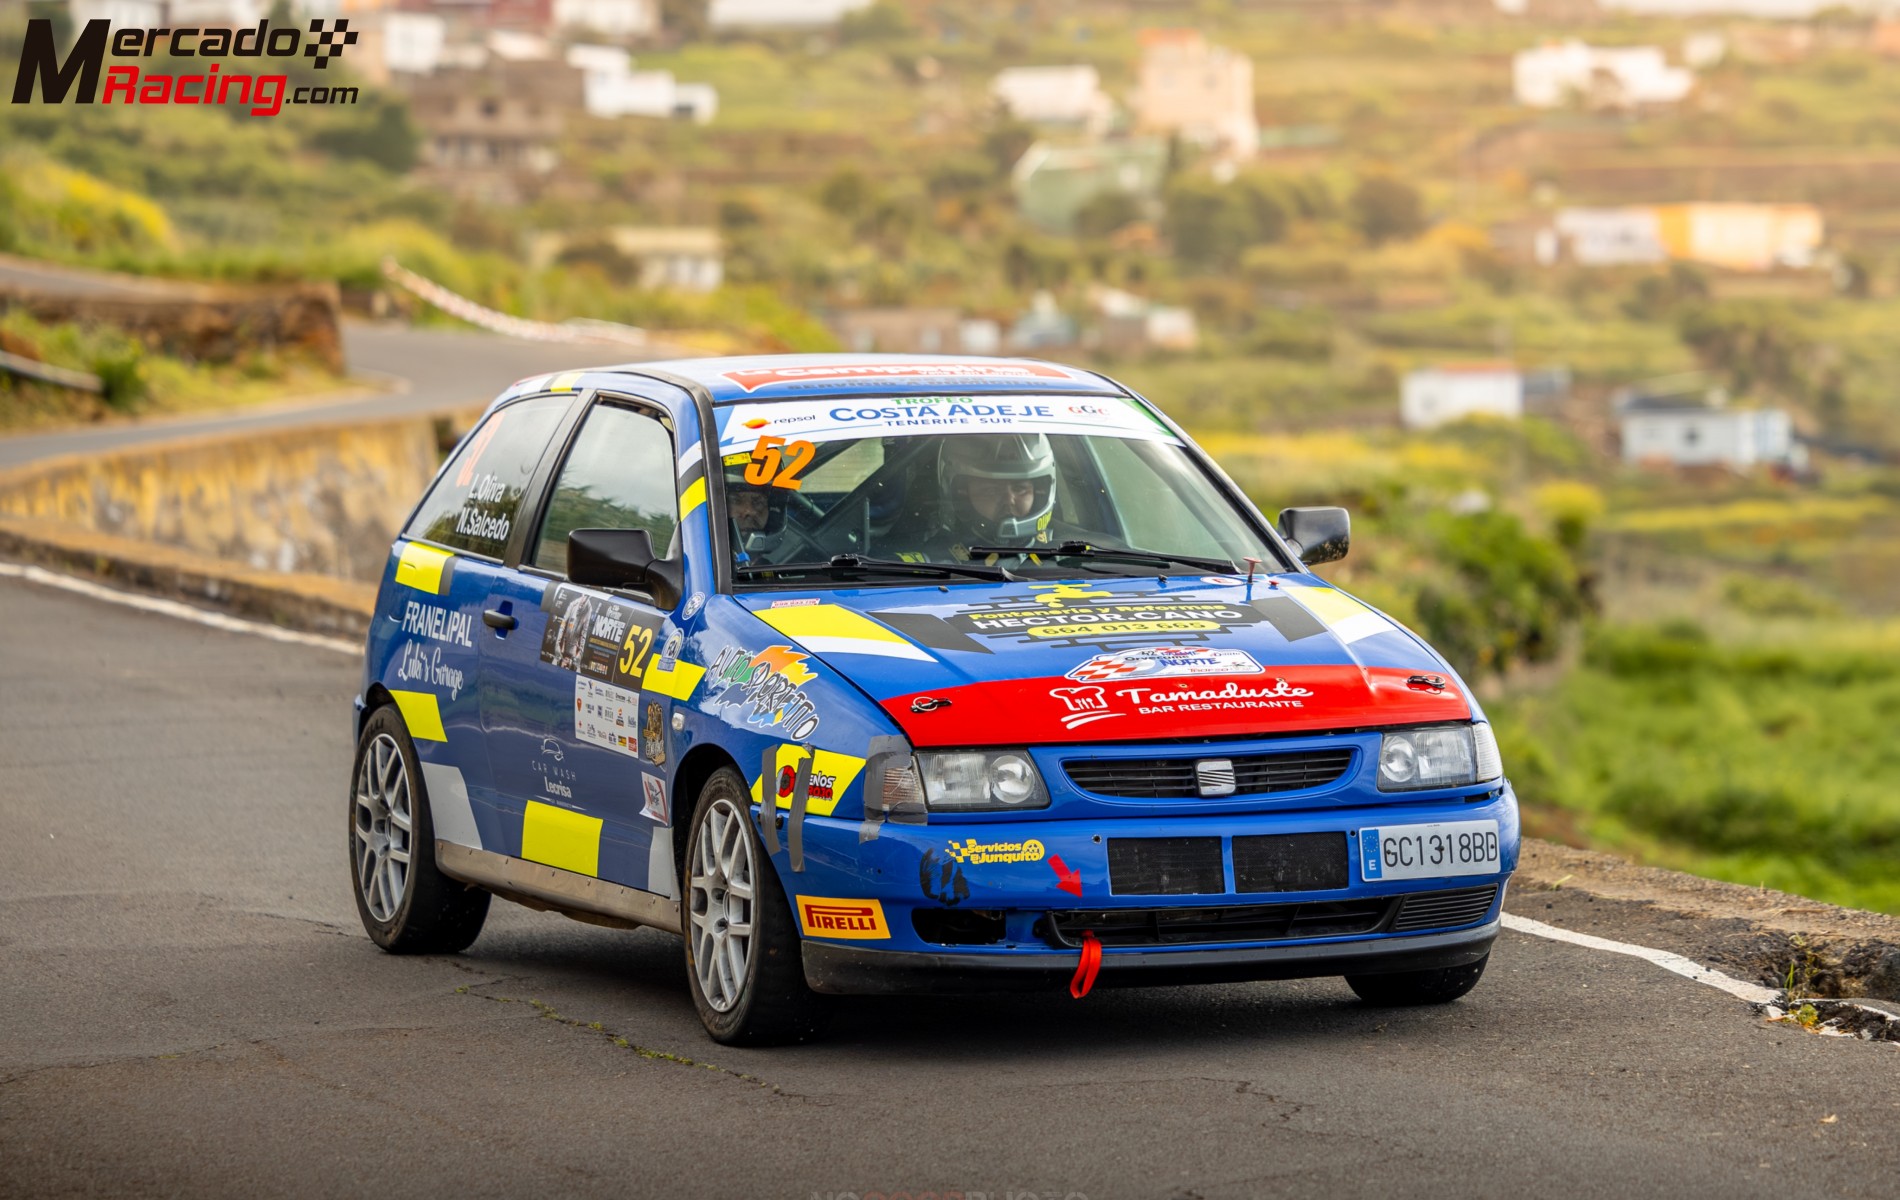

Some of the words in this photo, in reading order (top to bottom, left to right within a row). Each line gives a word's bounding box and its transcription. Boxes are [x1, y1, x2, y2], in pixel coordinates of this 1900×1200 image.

[891, 397, 973, 405] TROFEO
[774, 414, 816, 425] repsol
[829, 405, 941, 422] COSTA
[947, 404, 1054, 417] ADEJE
[885, 417, 969, 426] TENERIFE
[744, 435, 816, 490] 52
[456, 506, 510, 541] N.Salcedo
[1115, 604, 1227, 612] Reformas
[402, 600, 473, 648] FRANELIPAL
[592, 614, 626, 643] NORTE
[1101, 623, 1149, 632] 013
[620, 624, 653, 678] 52
[1115, 680, 1314, 704] Tamaduste
[1138, 705, 1176, 715] BAR
[1179, 700, 1304, 712] RESTAURANTE
[532, 760, 547, 773] CAR
[553, 766, 576, 781] WASH
[967, 842, 1022, 853] Servicios
[1368, 859, 1377, 871] E
[1383, 831, 1498, 868] GC1318BD
[804, 904, 877, 930] PIRELLI
